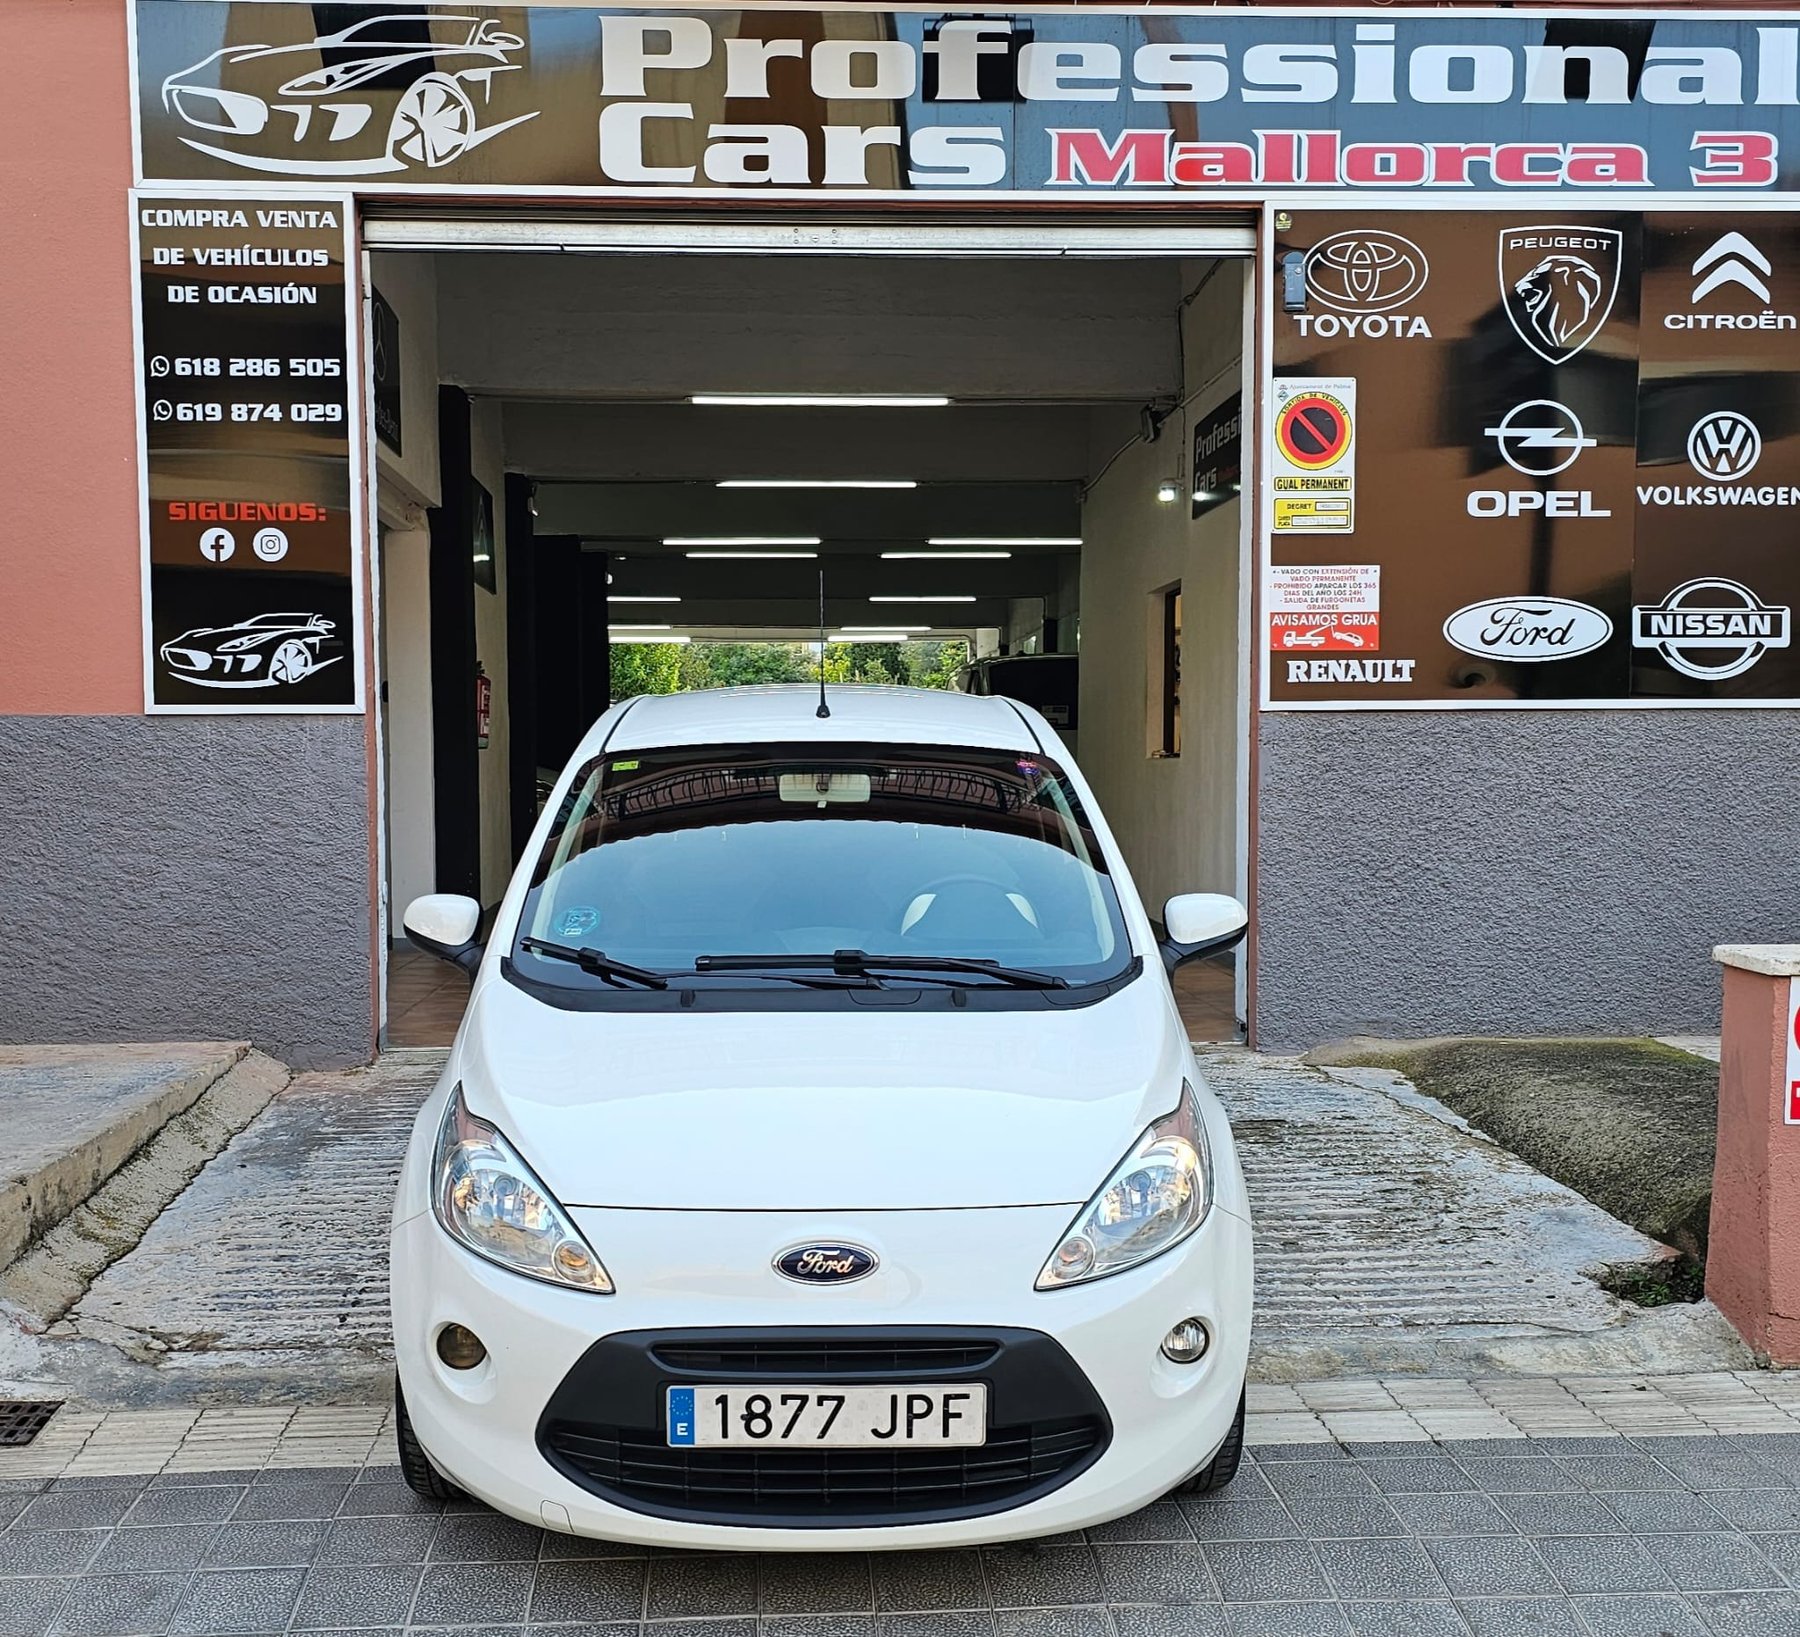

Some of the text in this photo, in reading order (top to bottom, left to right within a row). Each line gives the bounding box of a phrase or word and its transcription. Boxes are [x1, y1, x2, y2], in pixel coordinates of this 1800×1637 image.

[598, 15, 1800, 104] Professional
[599, 102, 1778, 187] Cars Mallorca 3
[141, 209, 338, 229] COMPRA VENTA
[1509, 236, 1612, 251] PEUGEOT
[153, 244, 329, 266] DE VEHÍCULOS
[167, 282, 317, 304] DE OCASIÓN
[1293, 314, 1433, 339] TOYOTA
[174, 357, 341, 377] 618 286 505
[176, 402, 342, 422] 619 874 029
[1194, 466, 1217, 493] Cars
[1276, 478, 1349, 490] GUAL PERMANENT
[1466, 490, 1612, 518] OPEL
[1636, 486, 1800, 506] VOLKSWAGEN
[168, 501, 327, 522] SIGUENOS:
[1271, 613, 1378, 626] AVISAMOS GRUA
[1480, 606, 1576, 646] Ford
[1651, 614, 1771, 636] NISSAN
[1286, 659, 1416, 682] RENAULT
[797, 1248, 854, 1275] Ford
[714, 1393, 971, 1440] 1877 JPF
[676, 1422, 688, 1436] E
